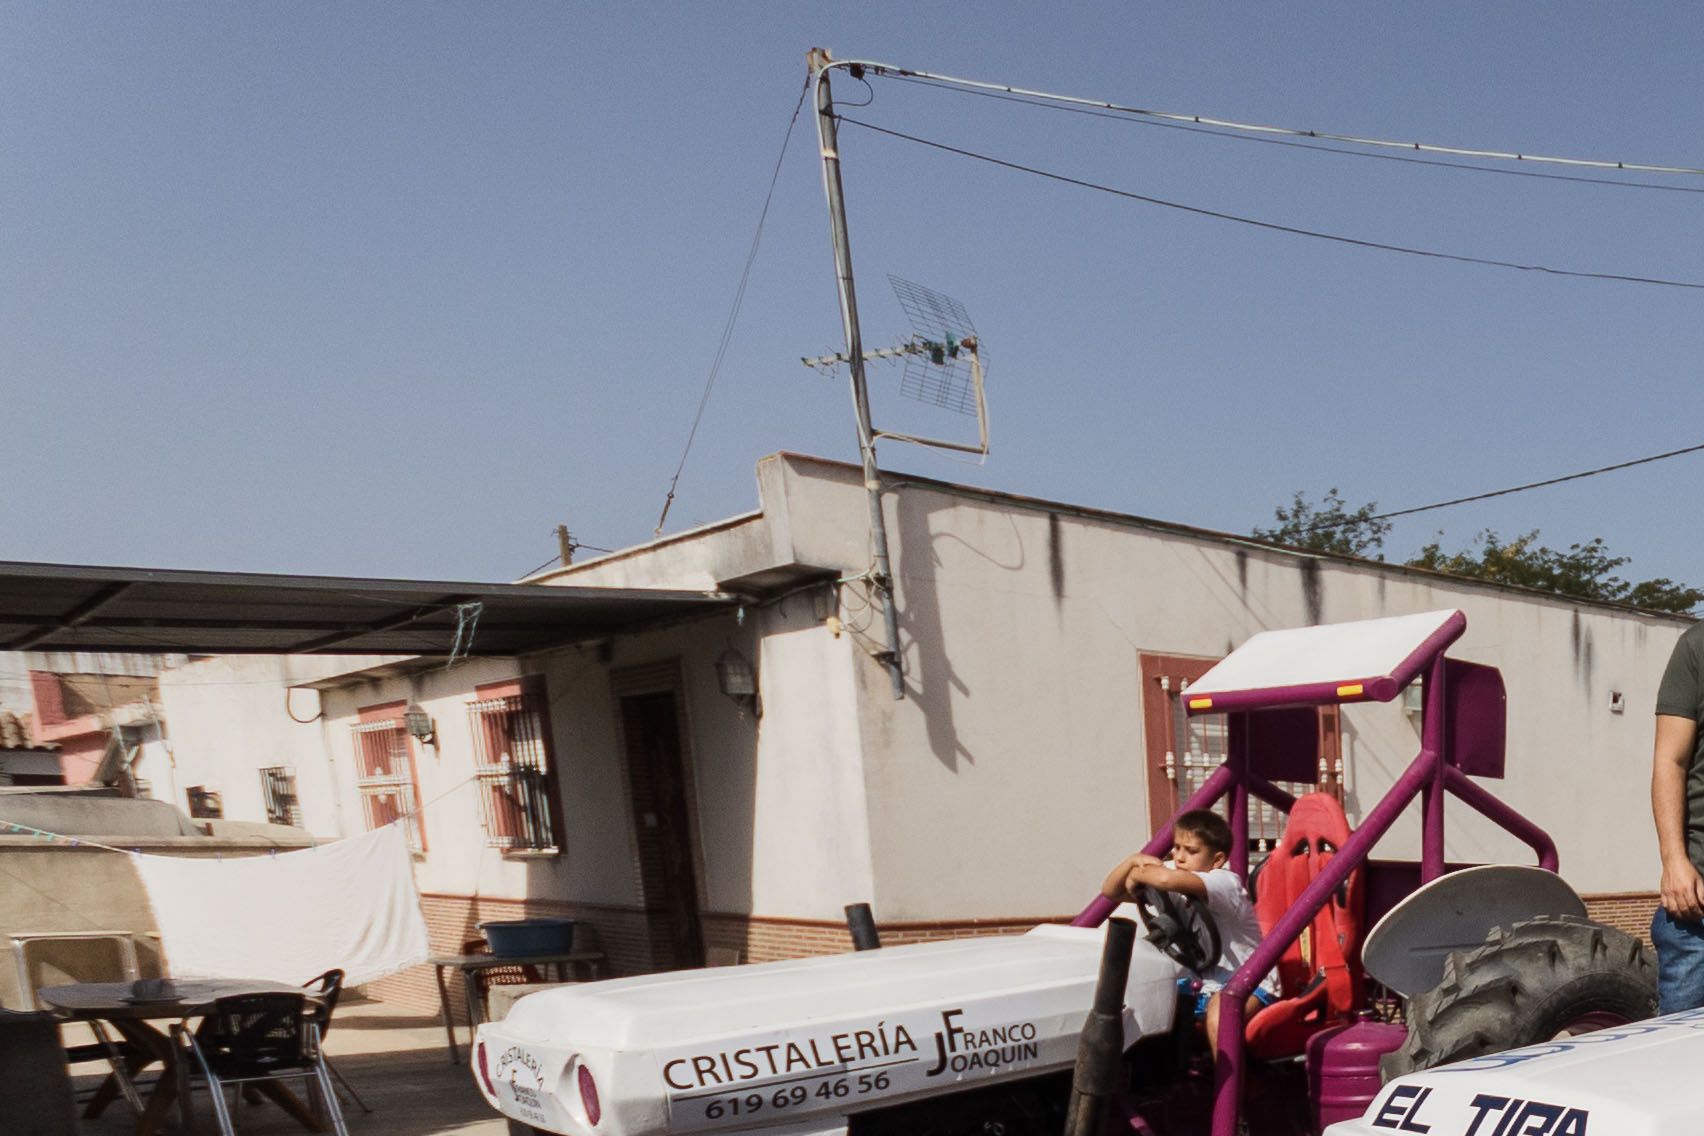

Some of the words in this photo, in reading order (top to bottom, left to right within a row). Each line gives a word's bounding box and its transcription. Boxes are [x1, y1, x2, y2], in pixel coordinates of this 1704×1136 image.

[662, 1021, 918, 1090] CRISTALERÍA
[704, 1098, 764, 1119] 619
[770, 1086, 807, 1109] 69
[814, 1077, 850, 1100] 46
[857, 1070, 891, 1092] 56
[1372, 1084, 1434, 1134] EL
